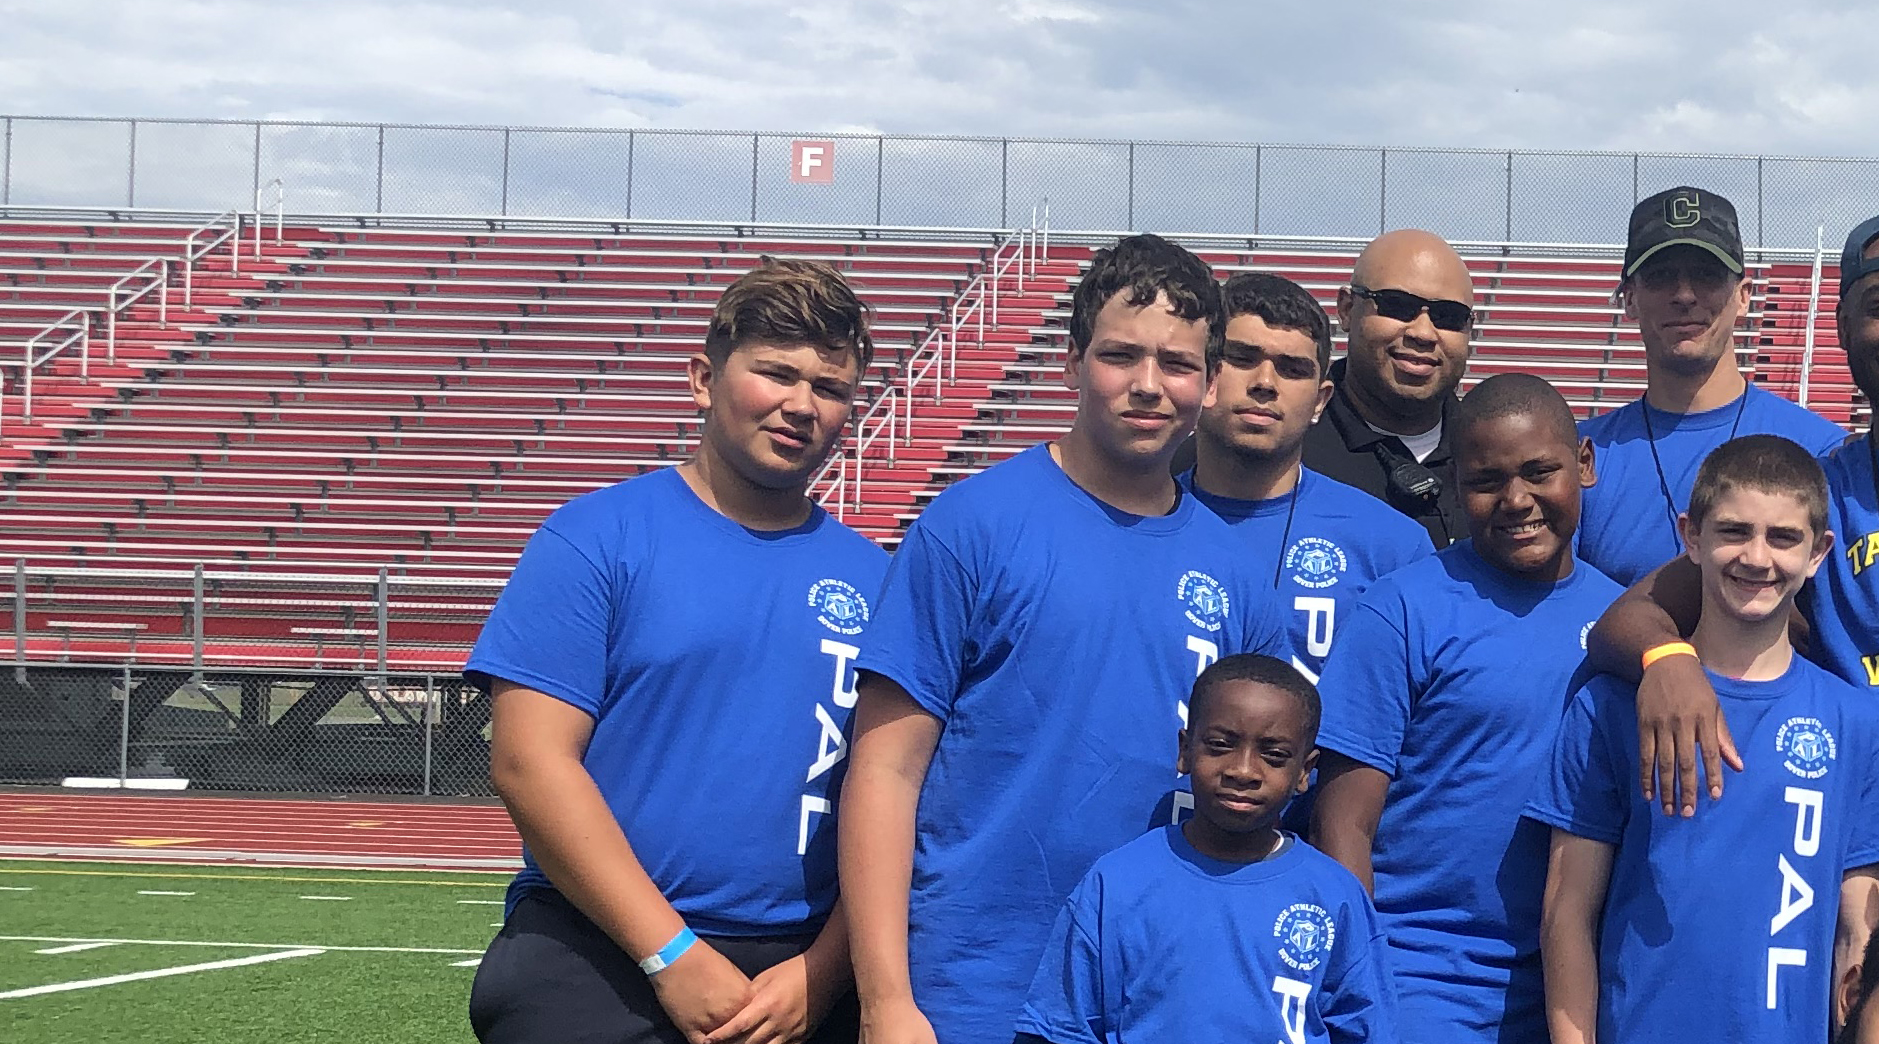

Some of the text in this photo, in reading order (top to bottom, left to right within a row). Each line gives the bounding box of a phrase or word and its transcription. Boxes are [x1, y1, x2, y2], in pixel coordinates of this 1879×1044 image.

[801, 147, 824, 176] F
[1664, 192, 1701, 228] C
[1289, 904, 1327, 917] ATHLETIC
[1766, 786, 1824, 1009] PAL
